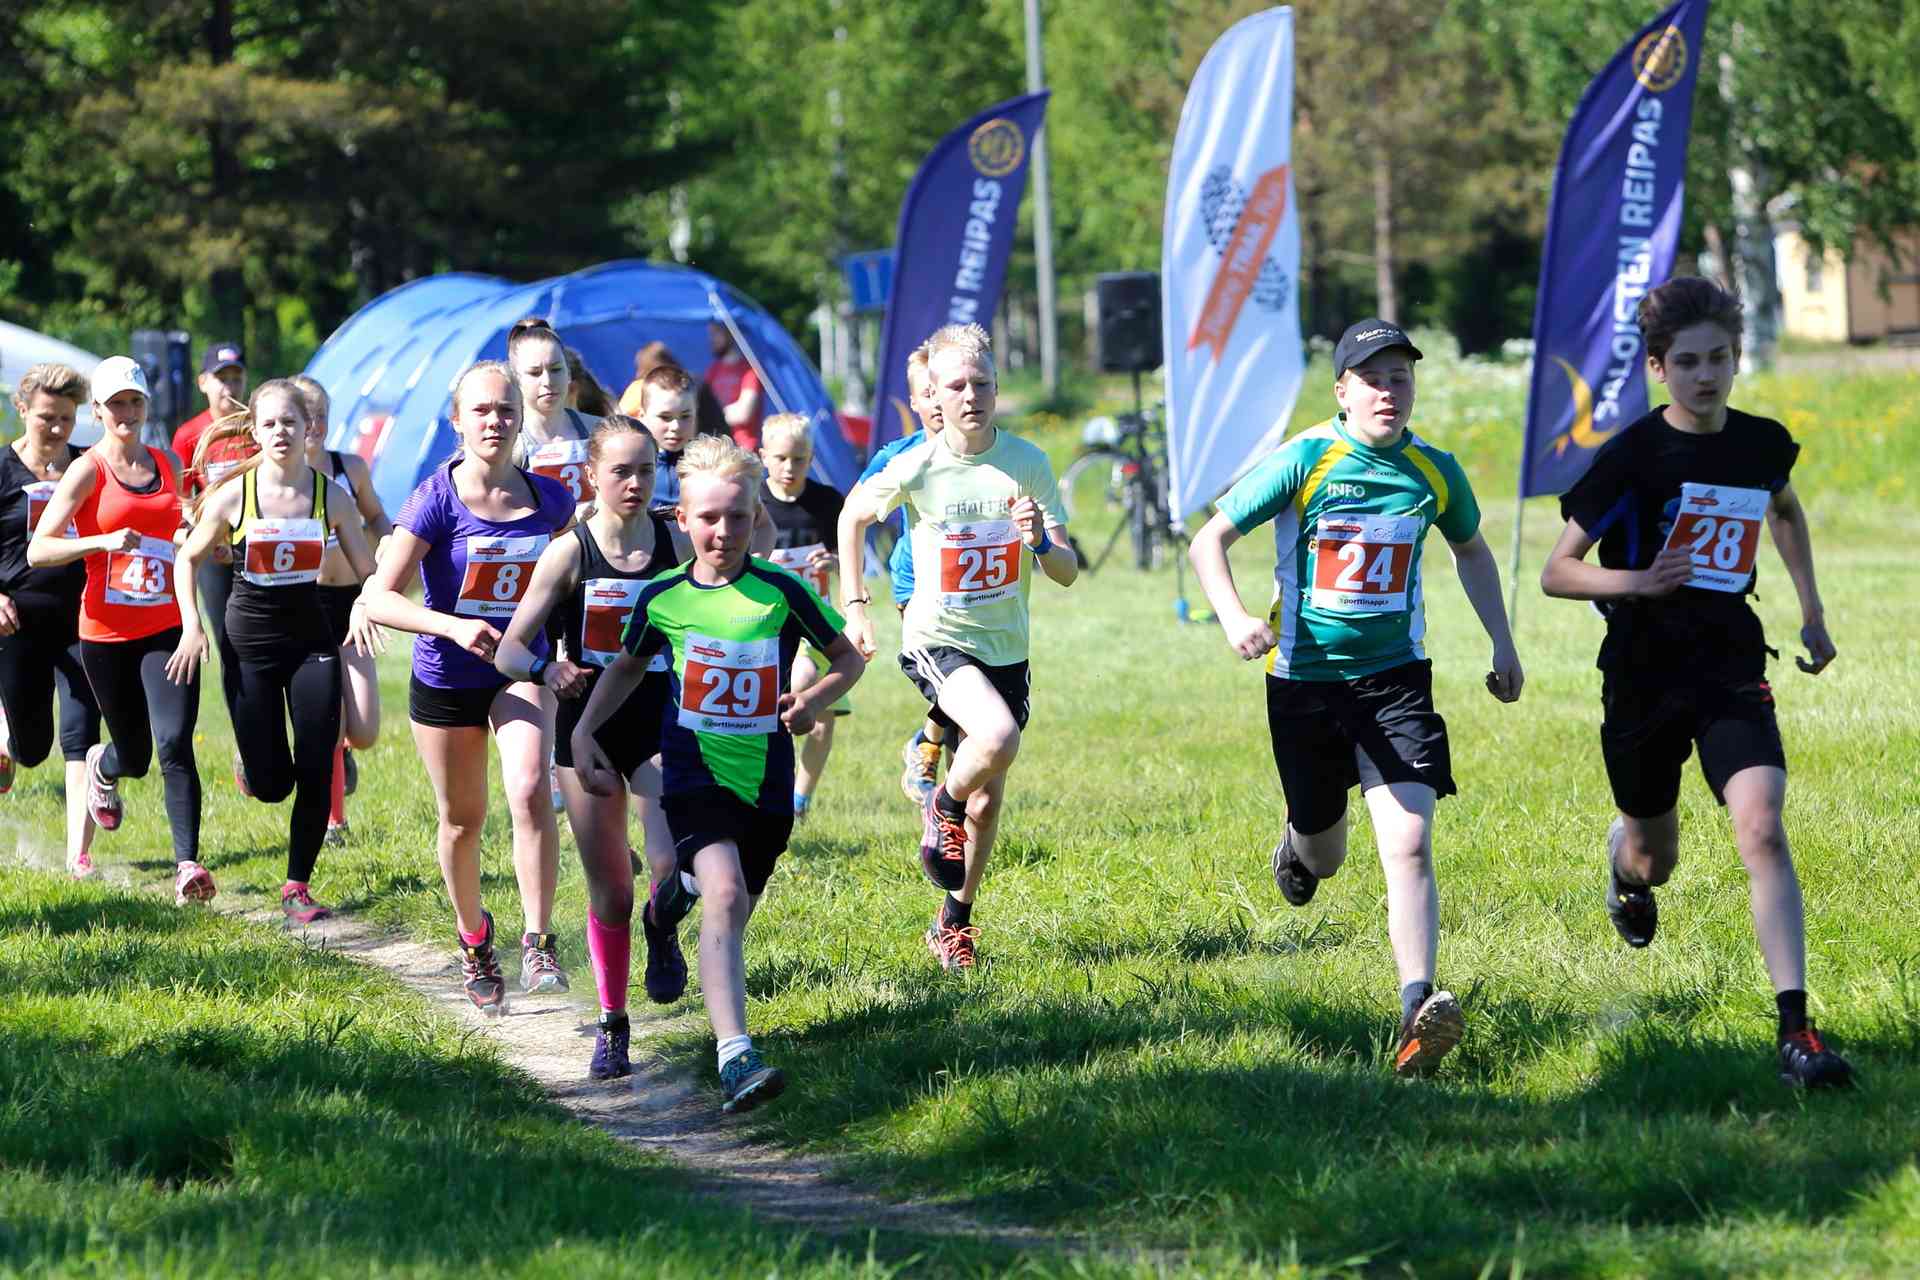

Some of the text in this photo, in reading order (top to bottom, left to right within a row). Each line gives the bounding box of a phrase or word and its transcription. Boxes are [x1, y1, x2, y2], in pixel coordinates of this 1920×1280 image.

[955, 178, 1003, 292] REIPAS
[1593, 97, 1663, 421] SALOISTEN REIPAS
[1327, 482, 1366, 498] INFO
[273, 542, 296, 572] 6
[1690, 517, 1745, 570] 28
[122, 556, 166, 594] 43
[493, 564, 521, 600] 8
[958, 548, 1008, 590] 25
[1334, 542, 1394, 592] 24
[700, 667, 761, 716] 29
